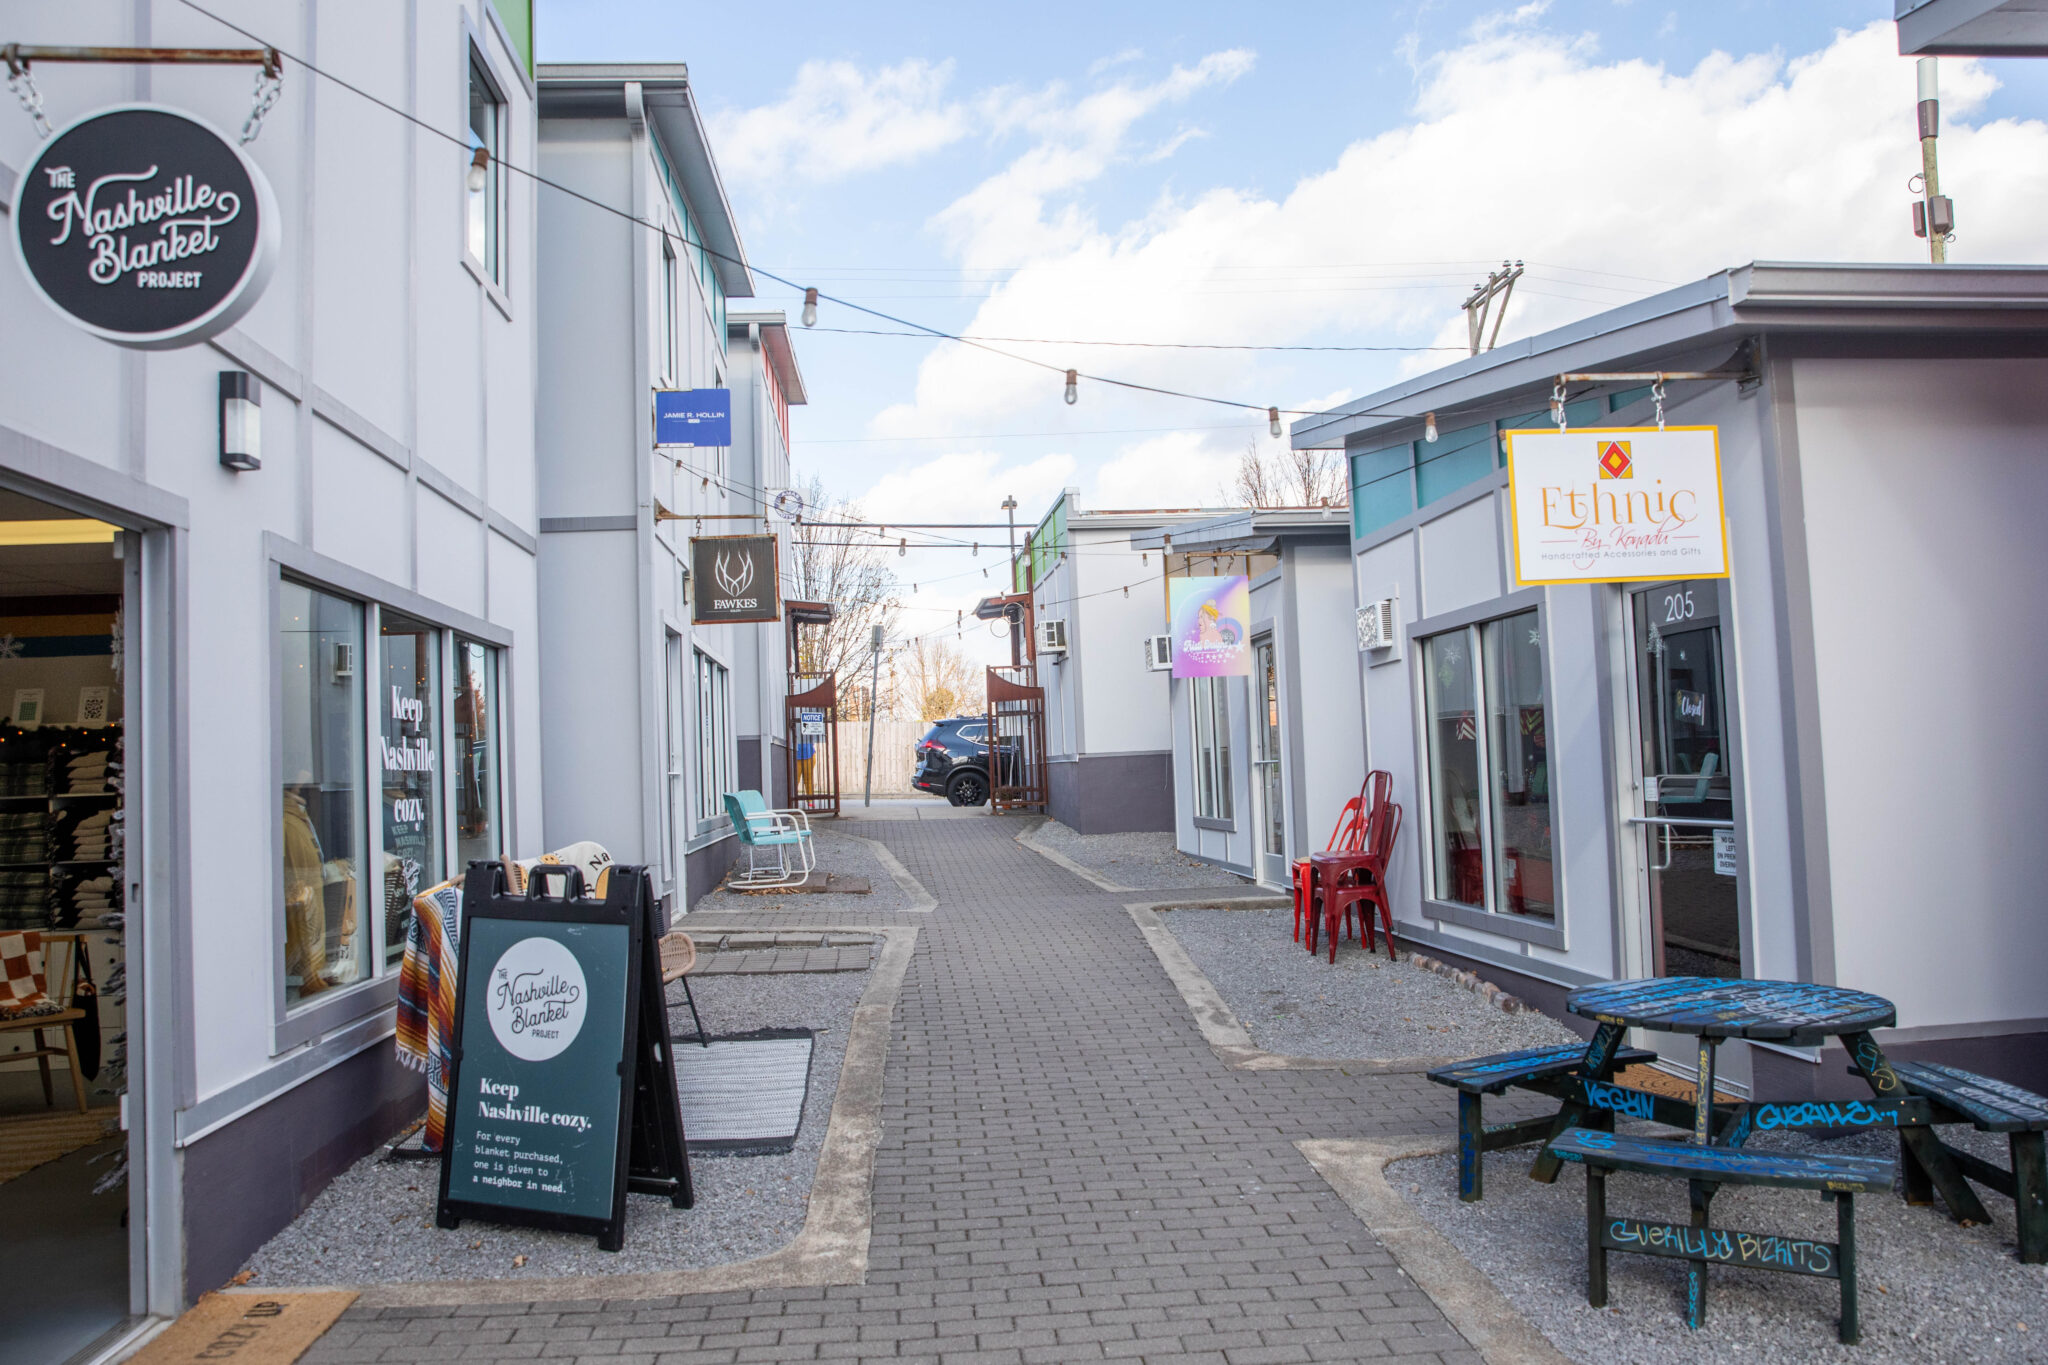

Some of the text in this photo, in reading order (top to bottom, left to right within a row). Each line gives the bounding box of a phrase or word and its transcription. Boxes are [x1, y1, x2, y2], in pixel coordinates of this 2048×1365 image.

[44, 166, 76, 188] THE
[47, 165, 217, 245] Nashville
[89, 192, 241, 284] Blanket
[137, 271, 203, 289] PROJECT
[663, 411, 685, 419] JAMIE
[1539, 479, 1698, 530] Ethnic
[1574, 515, 1684, 550] By Konadu
[1541, 547, 1701, 561] Handcrafted Accessories and Gifts
[713, 598, 758, 610] FAWKES
[1664, 590, 1695, 622] 205
[391, 685, 423, 732] Keep
[802, 713, 822, 721] NOTICE
[380, 735, 435, 772] Nashville
[393, 798, 425, 832] cozy.
[497, 968, 508, 980] THE
[497, 968, 569, 1010] Nashville
[511, 985, 580, 1034] Blanket
[531, 1029, 560, 1039] PROJECT
[480, 1077, 519, 1101] Keep
[479, 1101, 592, 1132] Nashville cozy.
[476, 1130, 521, 1146] For every
[475, 1145, 563, 1165] blanket purchased,
[473, 1161, 549, 1177] one is given to
[482, 1175, 523, 1188] neighbor
[526, 1179, 538, 1190] in
[541, 1181, 567, 1194] need.
[1737, 1232, 1832, 1272] BIZKITS
